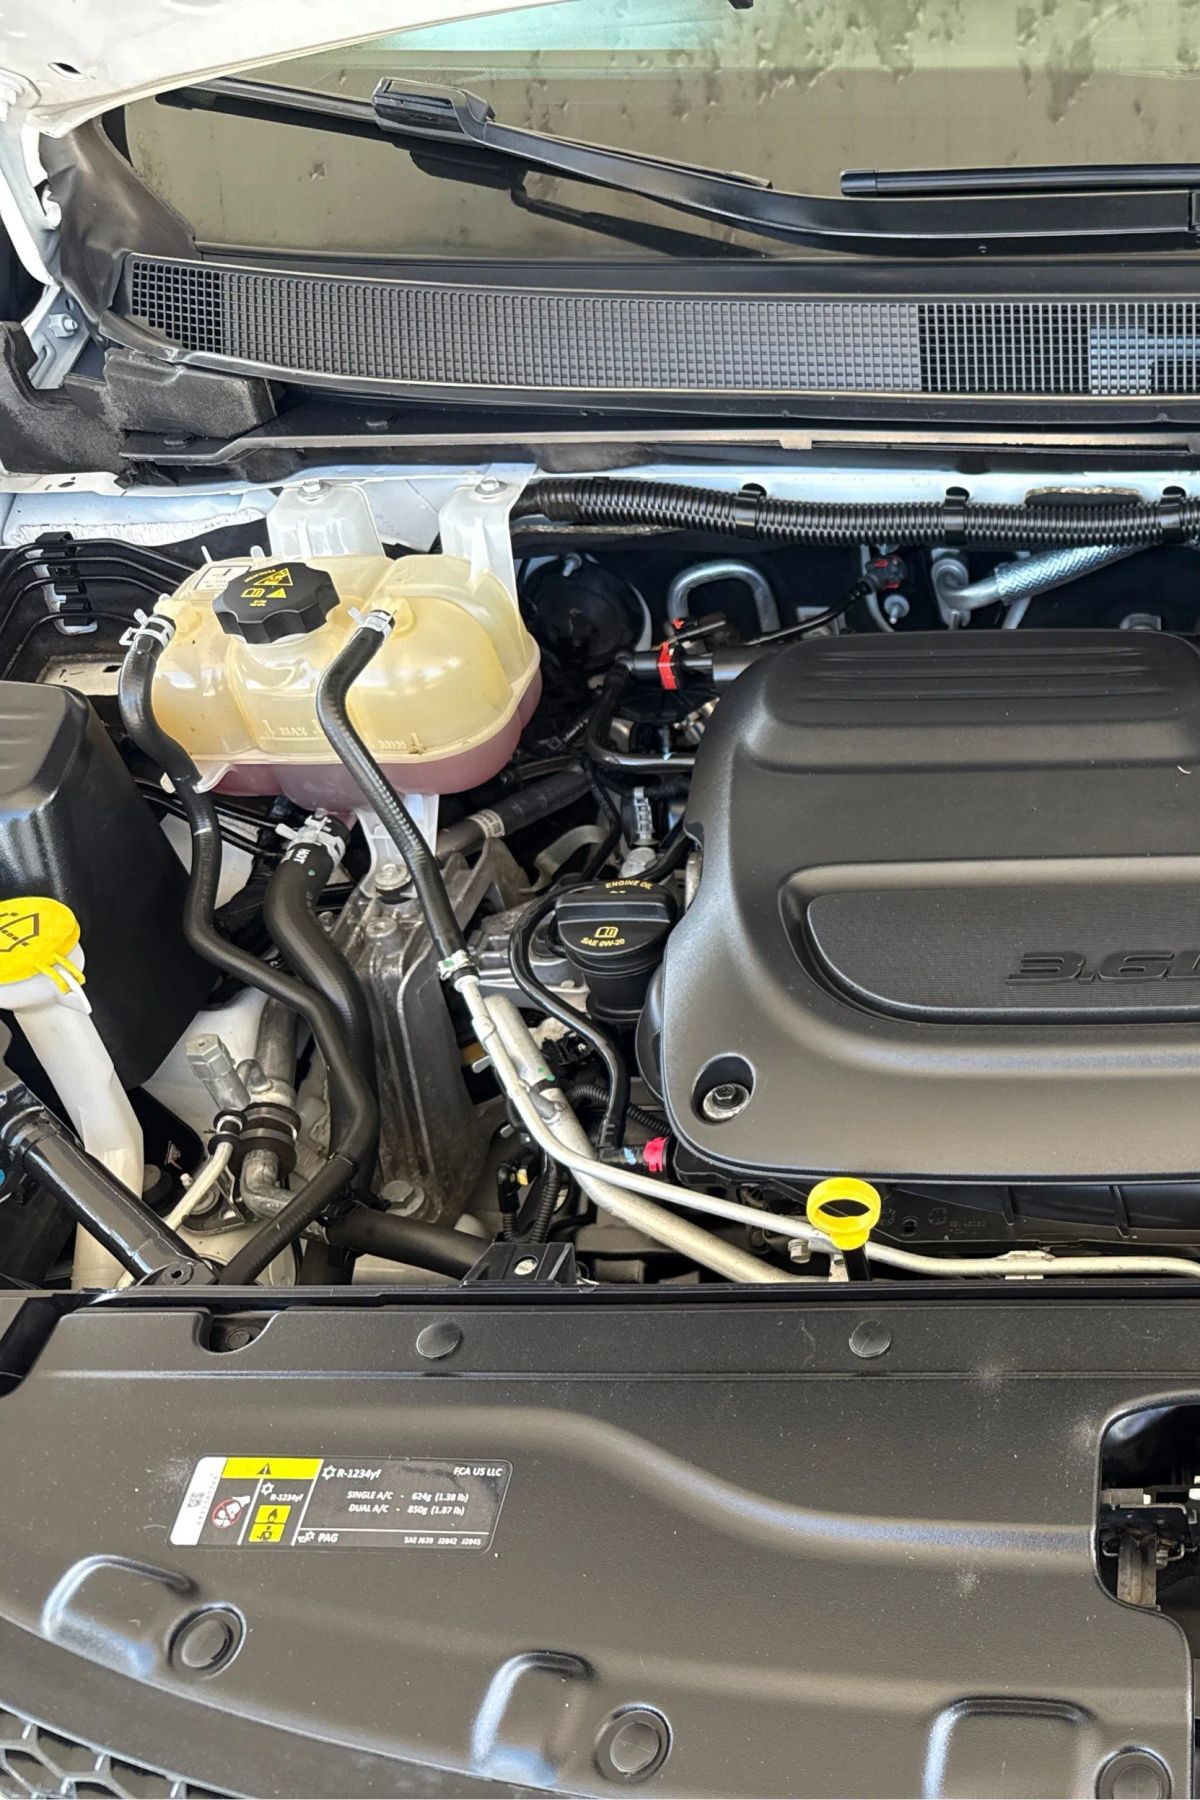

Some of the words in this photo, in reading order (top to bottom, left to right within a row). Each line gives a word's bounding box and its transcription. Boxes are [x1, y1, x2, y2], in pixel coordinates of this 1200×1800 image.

[605, 879, 639, 889] ENGINE
[640, 880, 654, 890] OIL
[581, 937, 597, 947] SAE
[599, 938, 625, 947] 0W-20
[337, 1468, 382, 1480] R-1234yf
[453, 1466, 470, 1476] FCA
[472, 1467, 485, 1476] US
[486, 1467, 503, 1477] LLC
[270, 1493, 304, 1502] R-1234yf
[347, 1491, 376, 1500] SINGLE
[377, 1491, 394, 1501] A/C
[411, 1492, 432, 1502] 624g
[434, 1492, 456, 1502] (1.38
[457, 1492, 469, 1503] lb)
[348, 1504, 371, 1513] DUAL
[372, 1504, 389, 1514] A/C
[407, 1505, 428, 1516] 850g
[430, 1505, 452, 1516] (1.87
[453, 1506, 465, 1516] lb)
[318, 1533, 339, 1543] PAG
[404, 1536, 417, 1545] SAE
